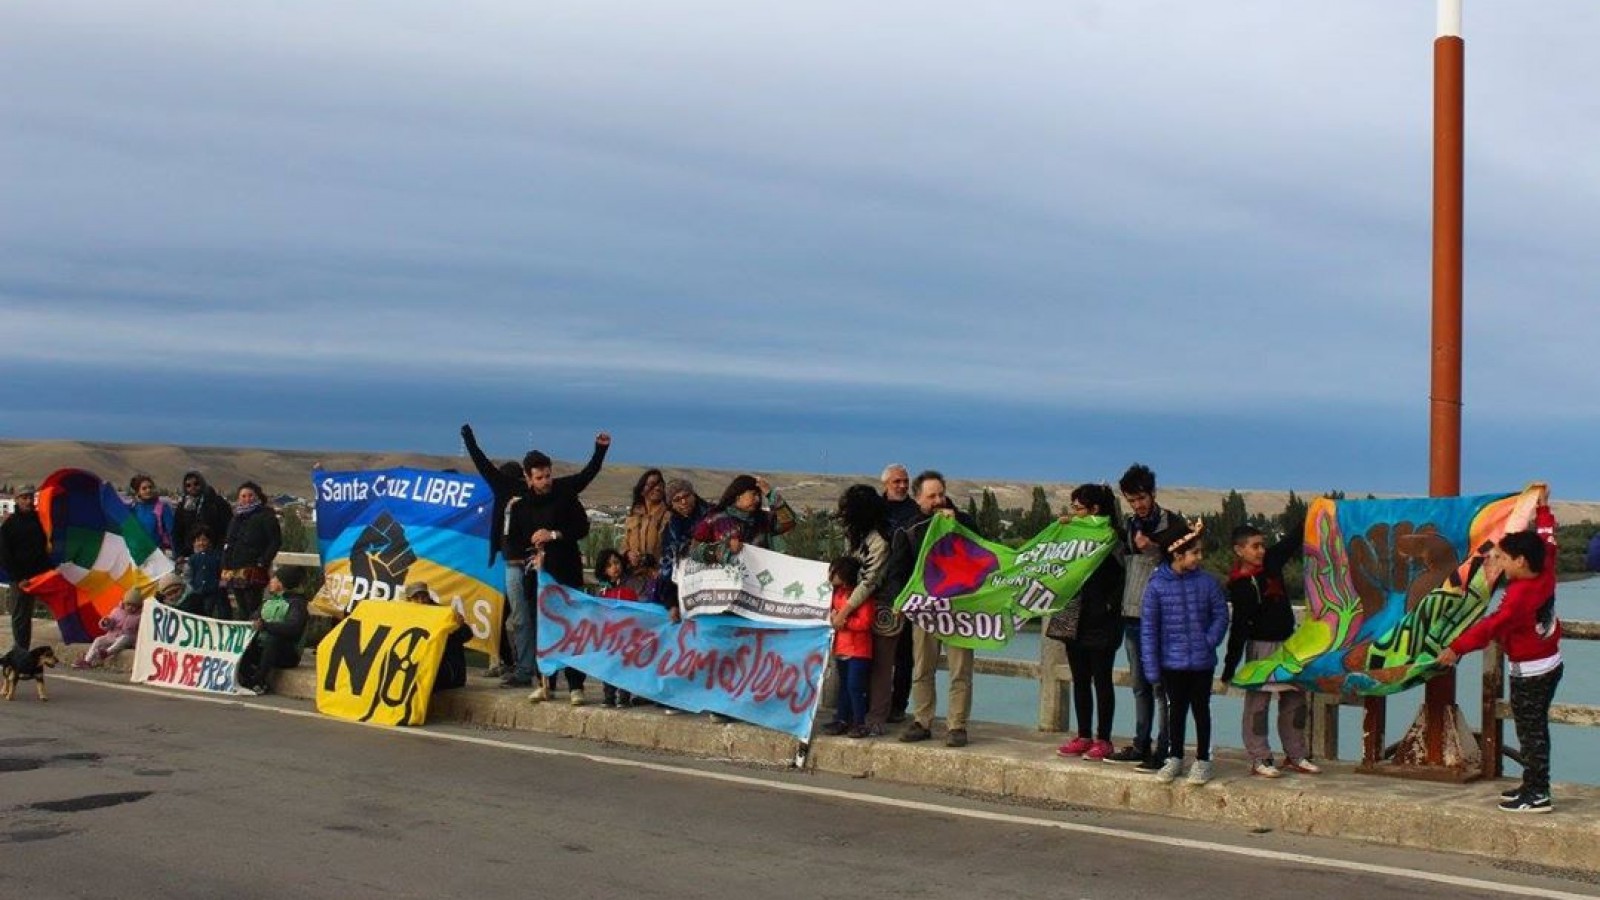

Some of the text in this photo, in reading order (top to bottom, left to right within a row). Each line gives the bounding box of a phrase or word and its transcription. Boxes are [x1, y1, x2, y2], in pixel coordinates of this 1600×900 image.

[321, 477, 368, 502] Santa
[372, 475, 407, 499] Cruz
[412, 476, 475, 507] LIBRE
